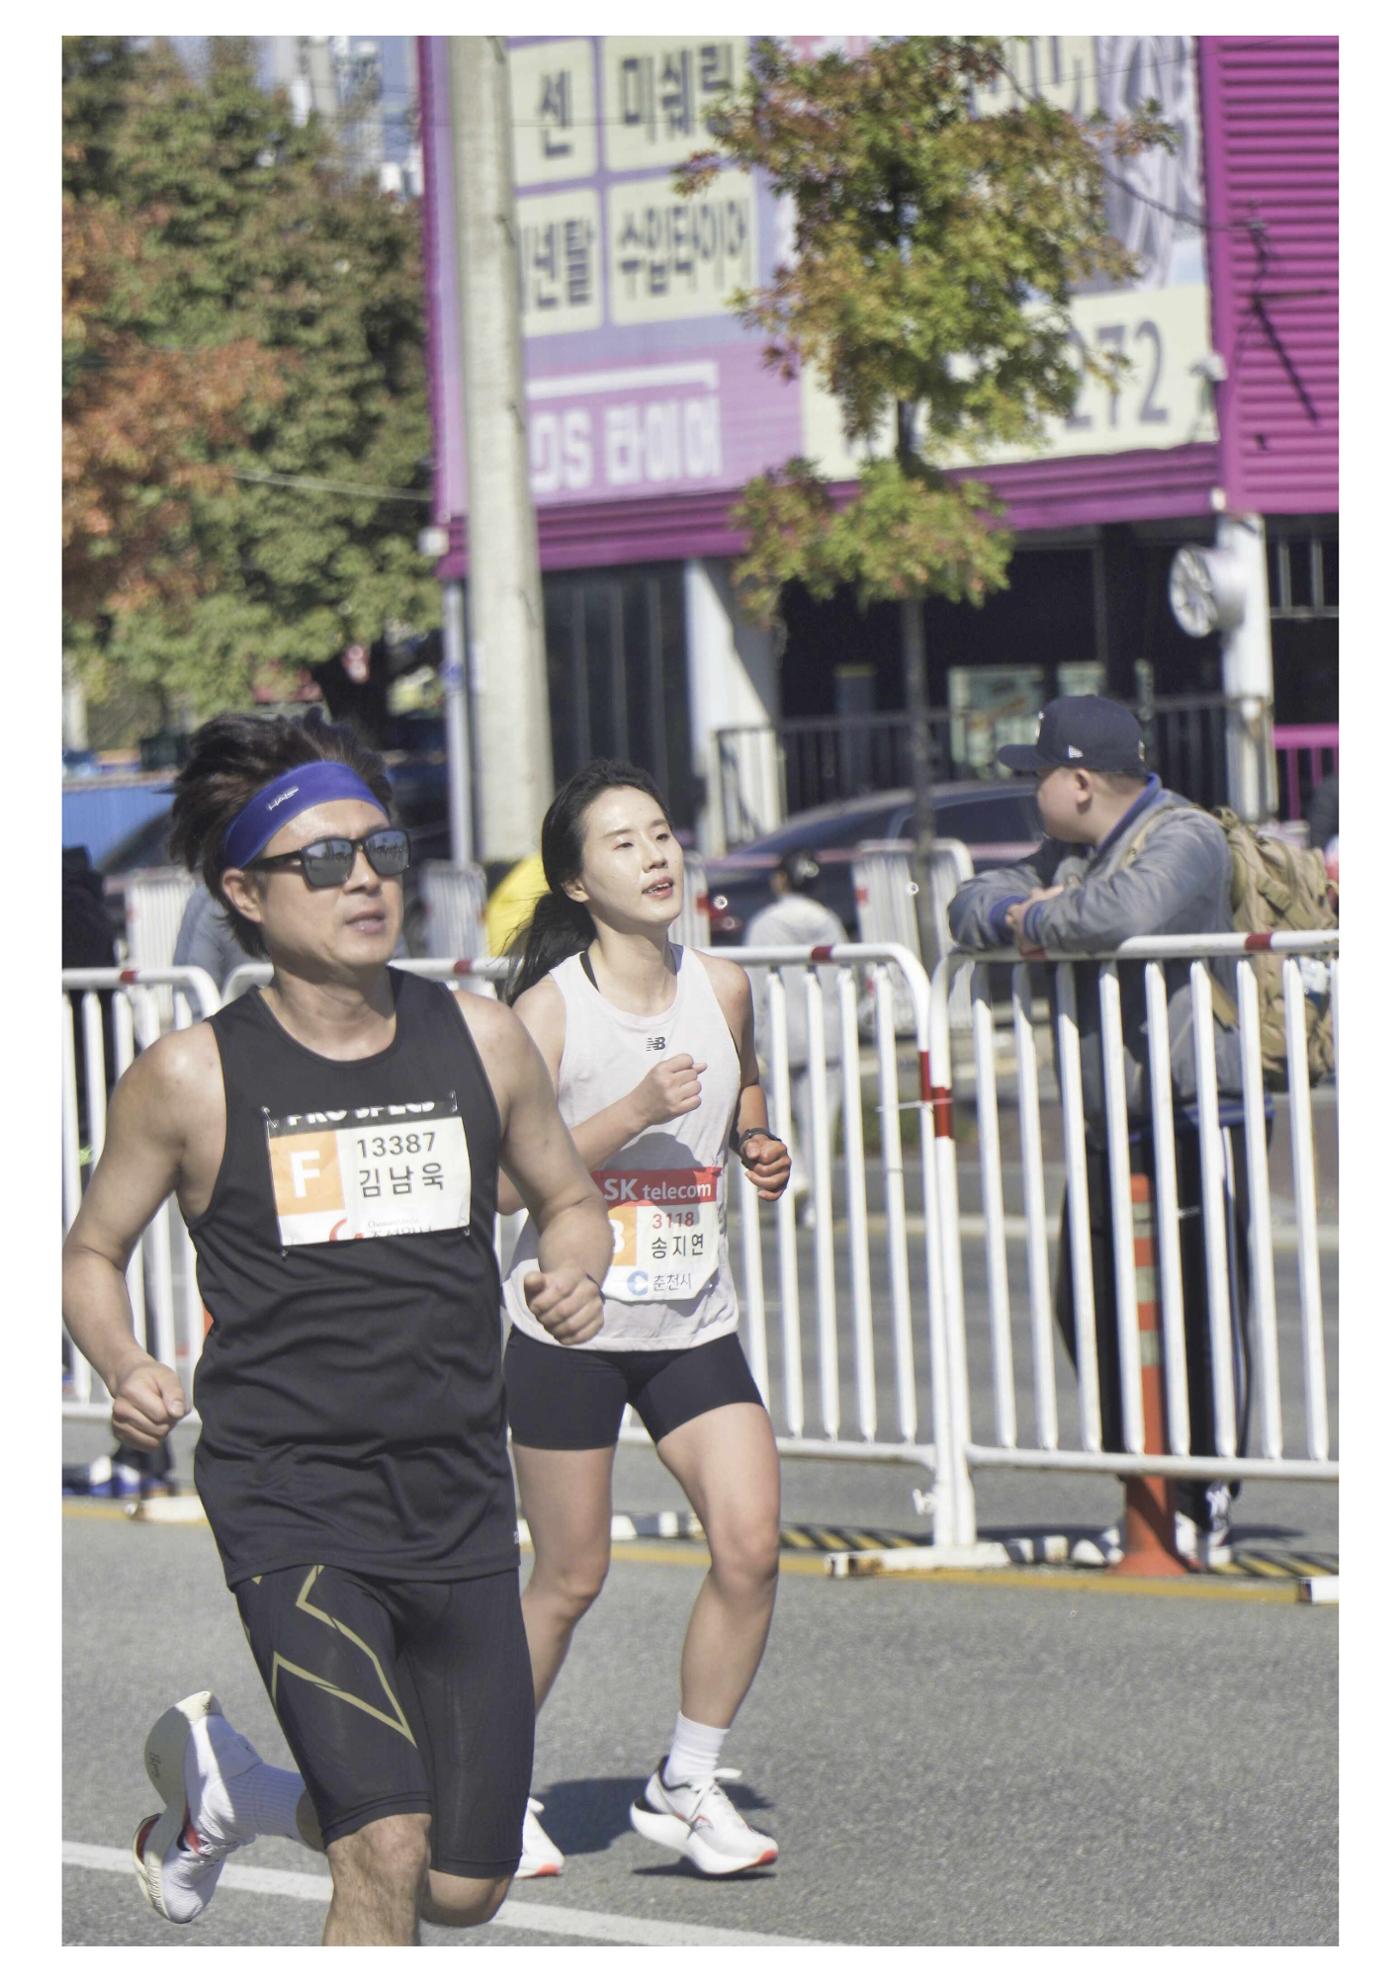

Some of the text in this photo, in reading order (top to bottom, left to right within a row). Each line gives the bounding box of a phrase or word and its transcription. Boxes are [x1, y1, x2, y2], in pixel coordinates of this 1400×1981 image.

[356, 1132, 436, 1158] 13387
[290, 1150, 321, 1198] F
[359, 1162, 444, 1198] 김남욱
[603, 1178, 712, 1201] SK telecom
[652, 1211, 695, 1229] 3118
[651, 1233, 704, 1259] 송지연
